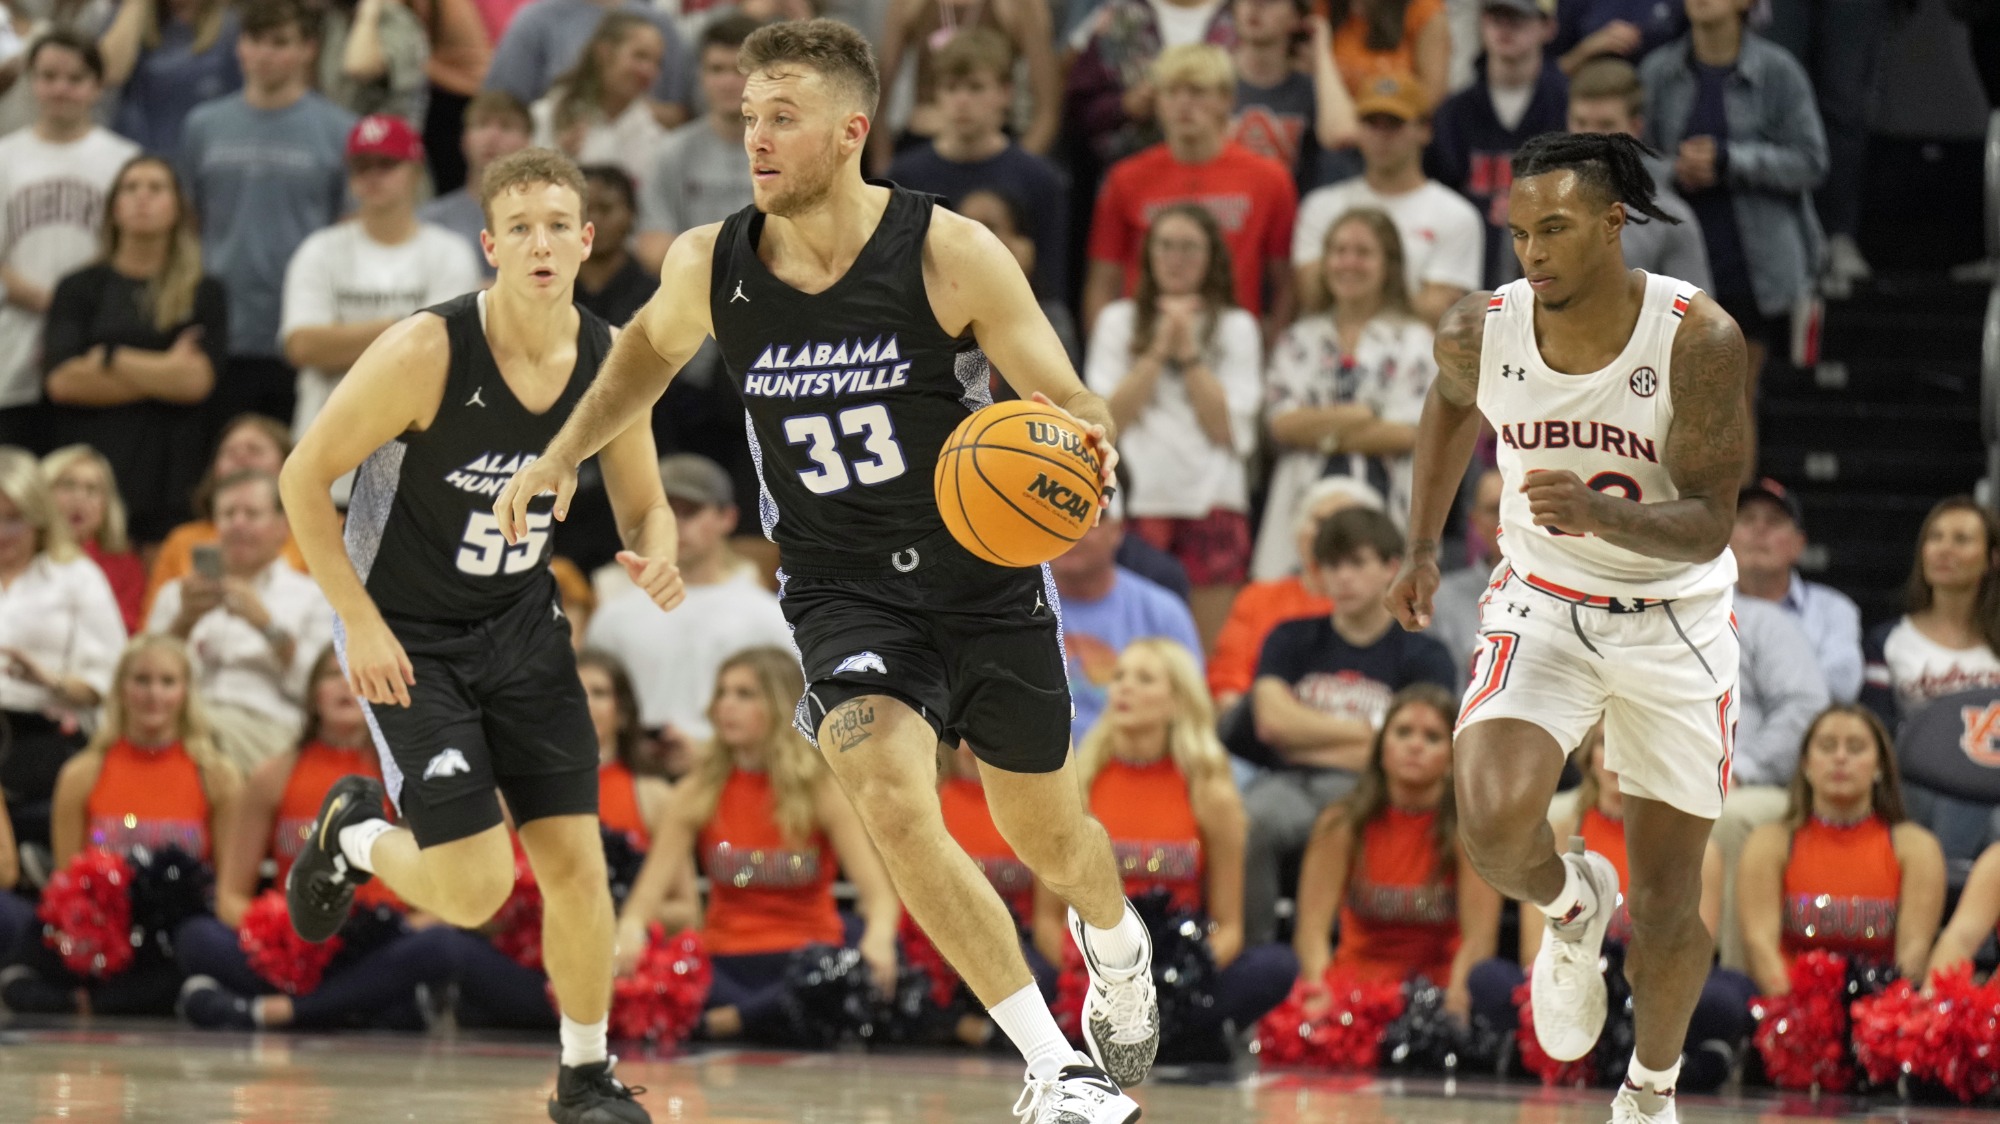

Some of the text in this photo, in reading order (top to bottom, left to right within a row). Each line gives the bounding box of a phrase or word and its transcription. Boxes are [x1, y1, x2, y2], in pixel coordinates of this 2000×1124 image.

[750, 333, 900, 371] ALABAMA
[744, 359, 912, 401] HUNTSVILLE
[1631, 368, 1656, 396] SEC
[781, 402, 908, 496] 33
[1025, 421, 1100, 474] Wilso
[1502, 420, 1659, 464] AUBURN
[1027, 472, 1092, 523] NCAA
[455, 508, 553, 577] 55
